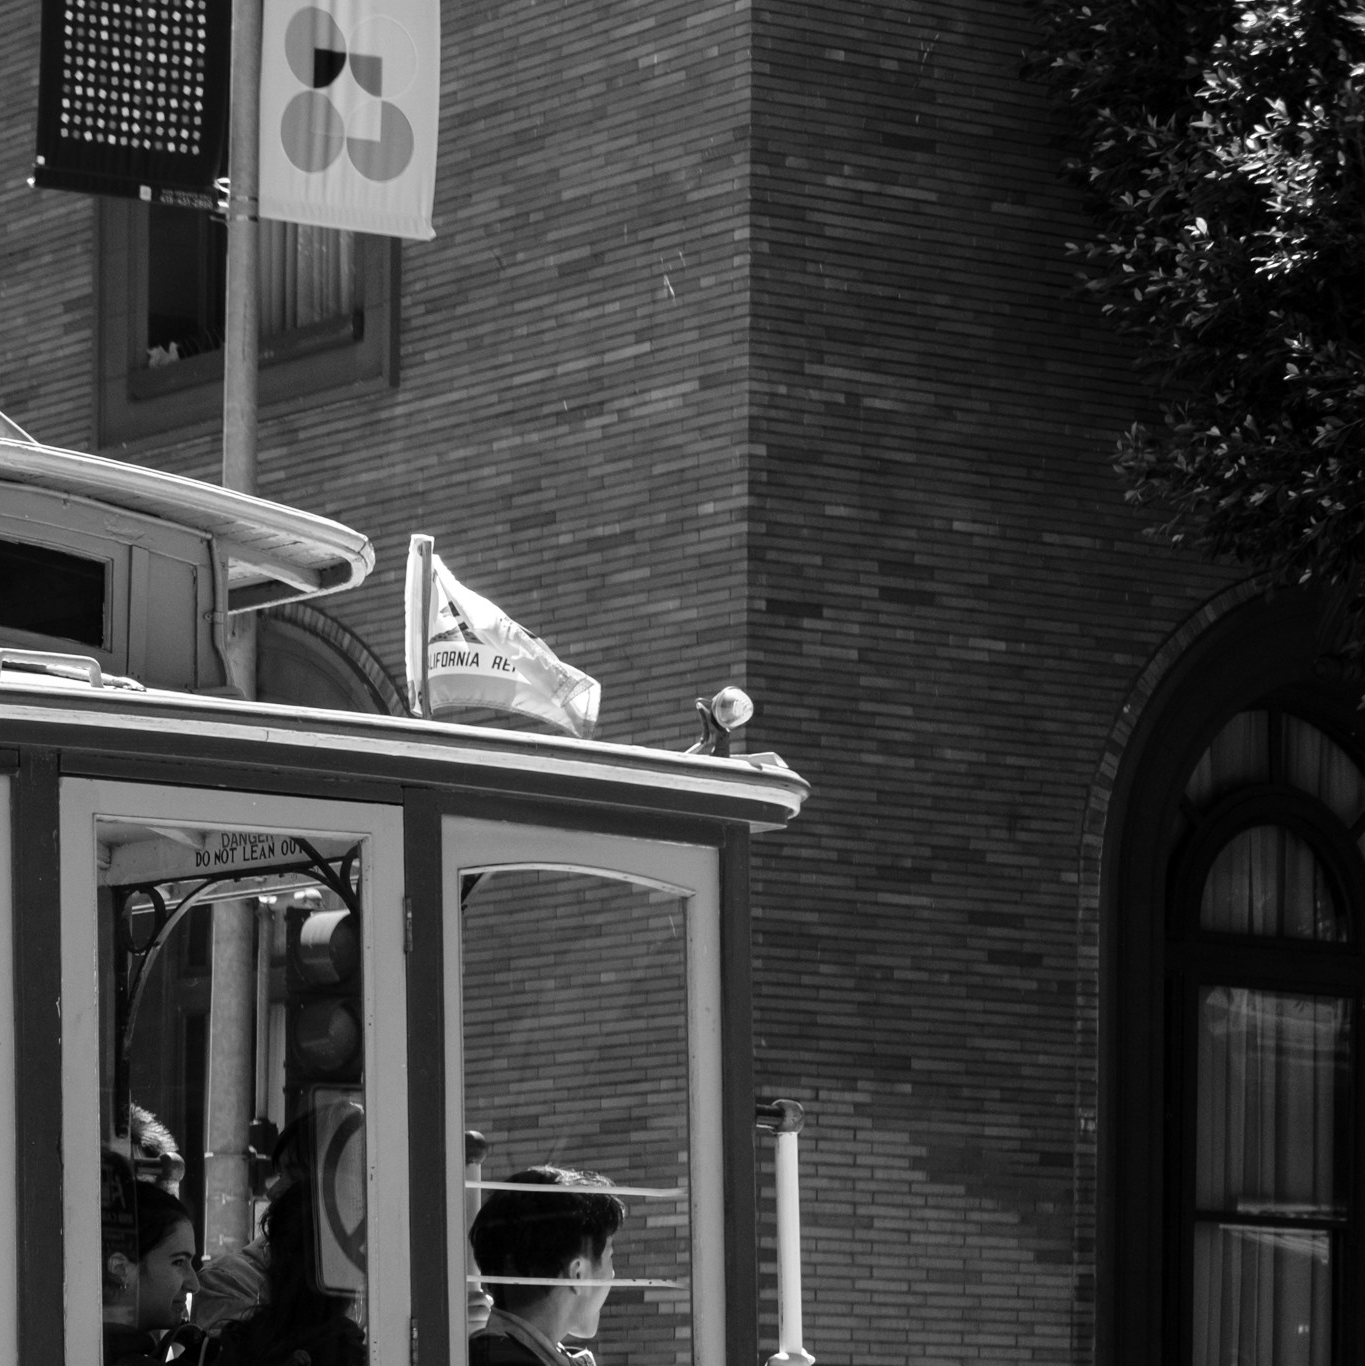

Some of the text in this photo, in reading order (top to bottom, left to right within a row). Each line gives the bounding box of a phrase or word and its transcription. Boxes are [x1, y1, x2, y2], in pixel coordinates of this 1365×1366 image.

[428, 651, 479, 670] LIFORNIA
[195, 840, 303, 867] DO NOT LEAN OU
